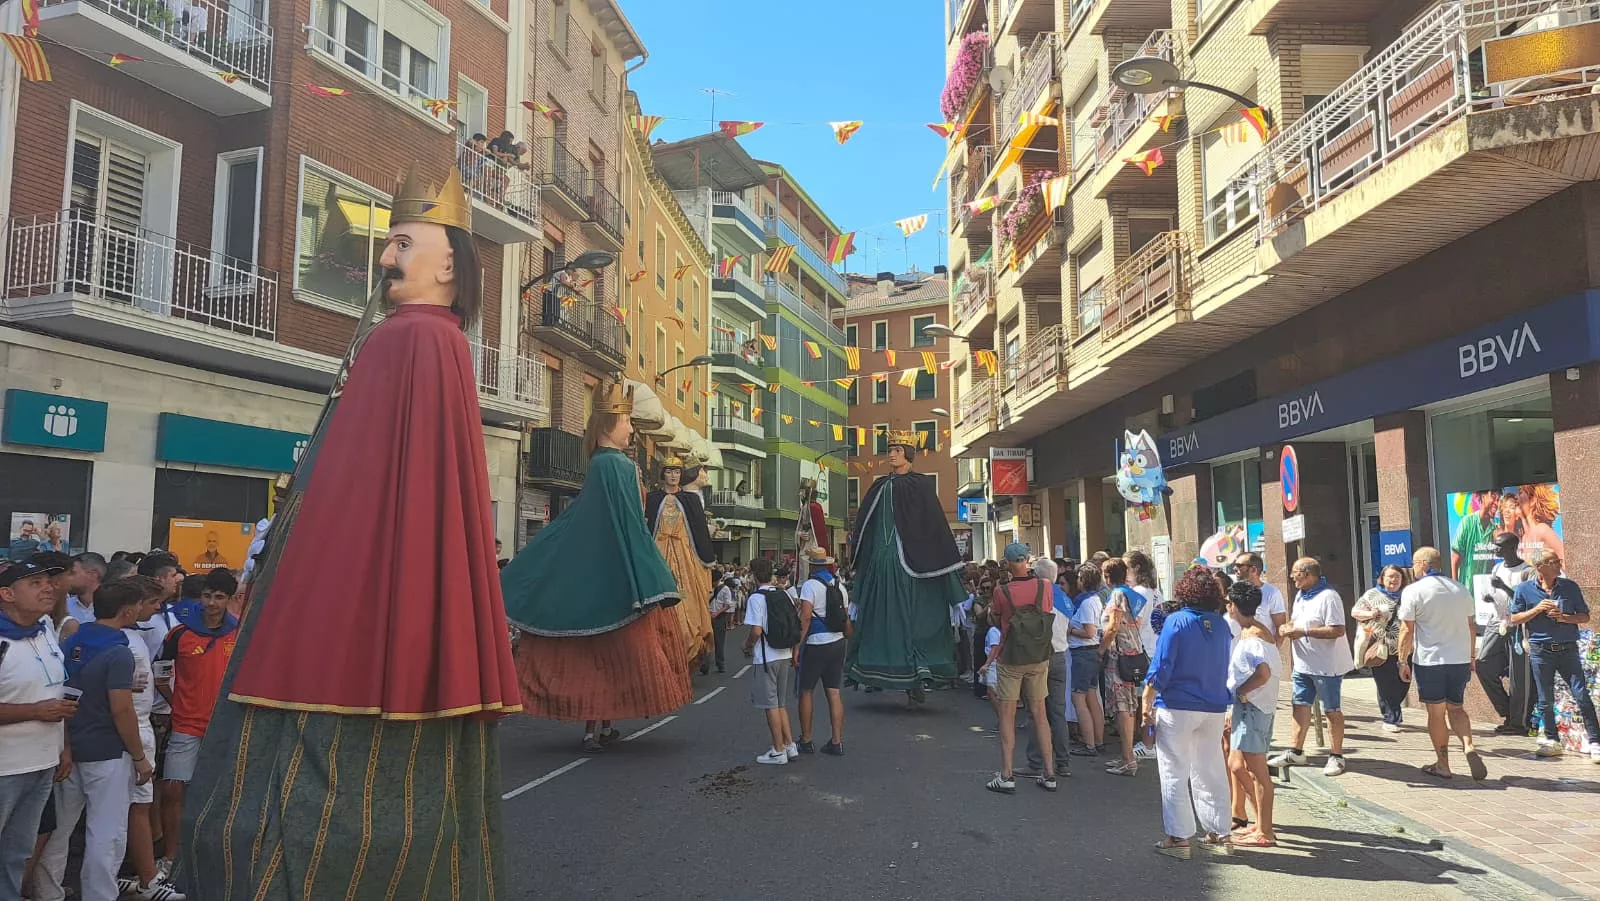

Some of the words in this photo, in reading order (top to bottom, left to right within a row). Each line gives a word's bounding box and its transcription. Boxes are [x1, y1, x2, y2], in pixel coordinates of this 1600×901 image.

[1459, 321, 1542, 378] BBVA
[1279, 391, 1324, 429] BBVA
[1170, 431, 1199, 459] BBVA
[1384, 542, 1407, 556] BBVA
